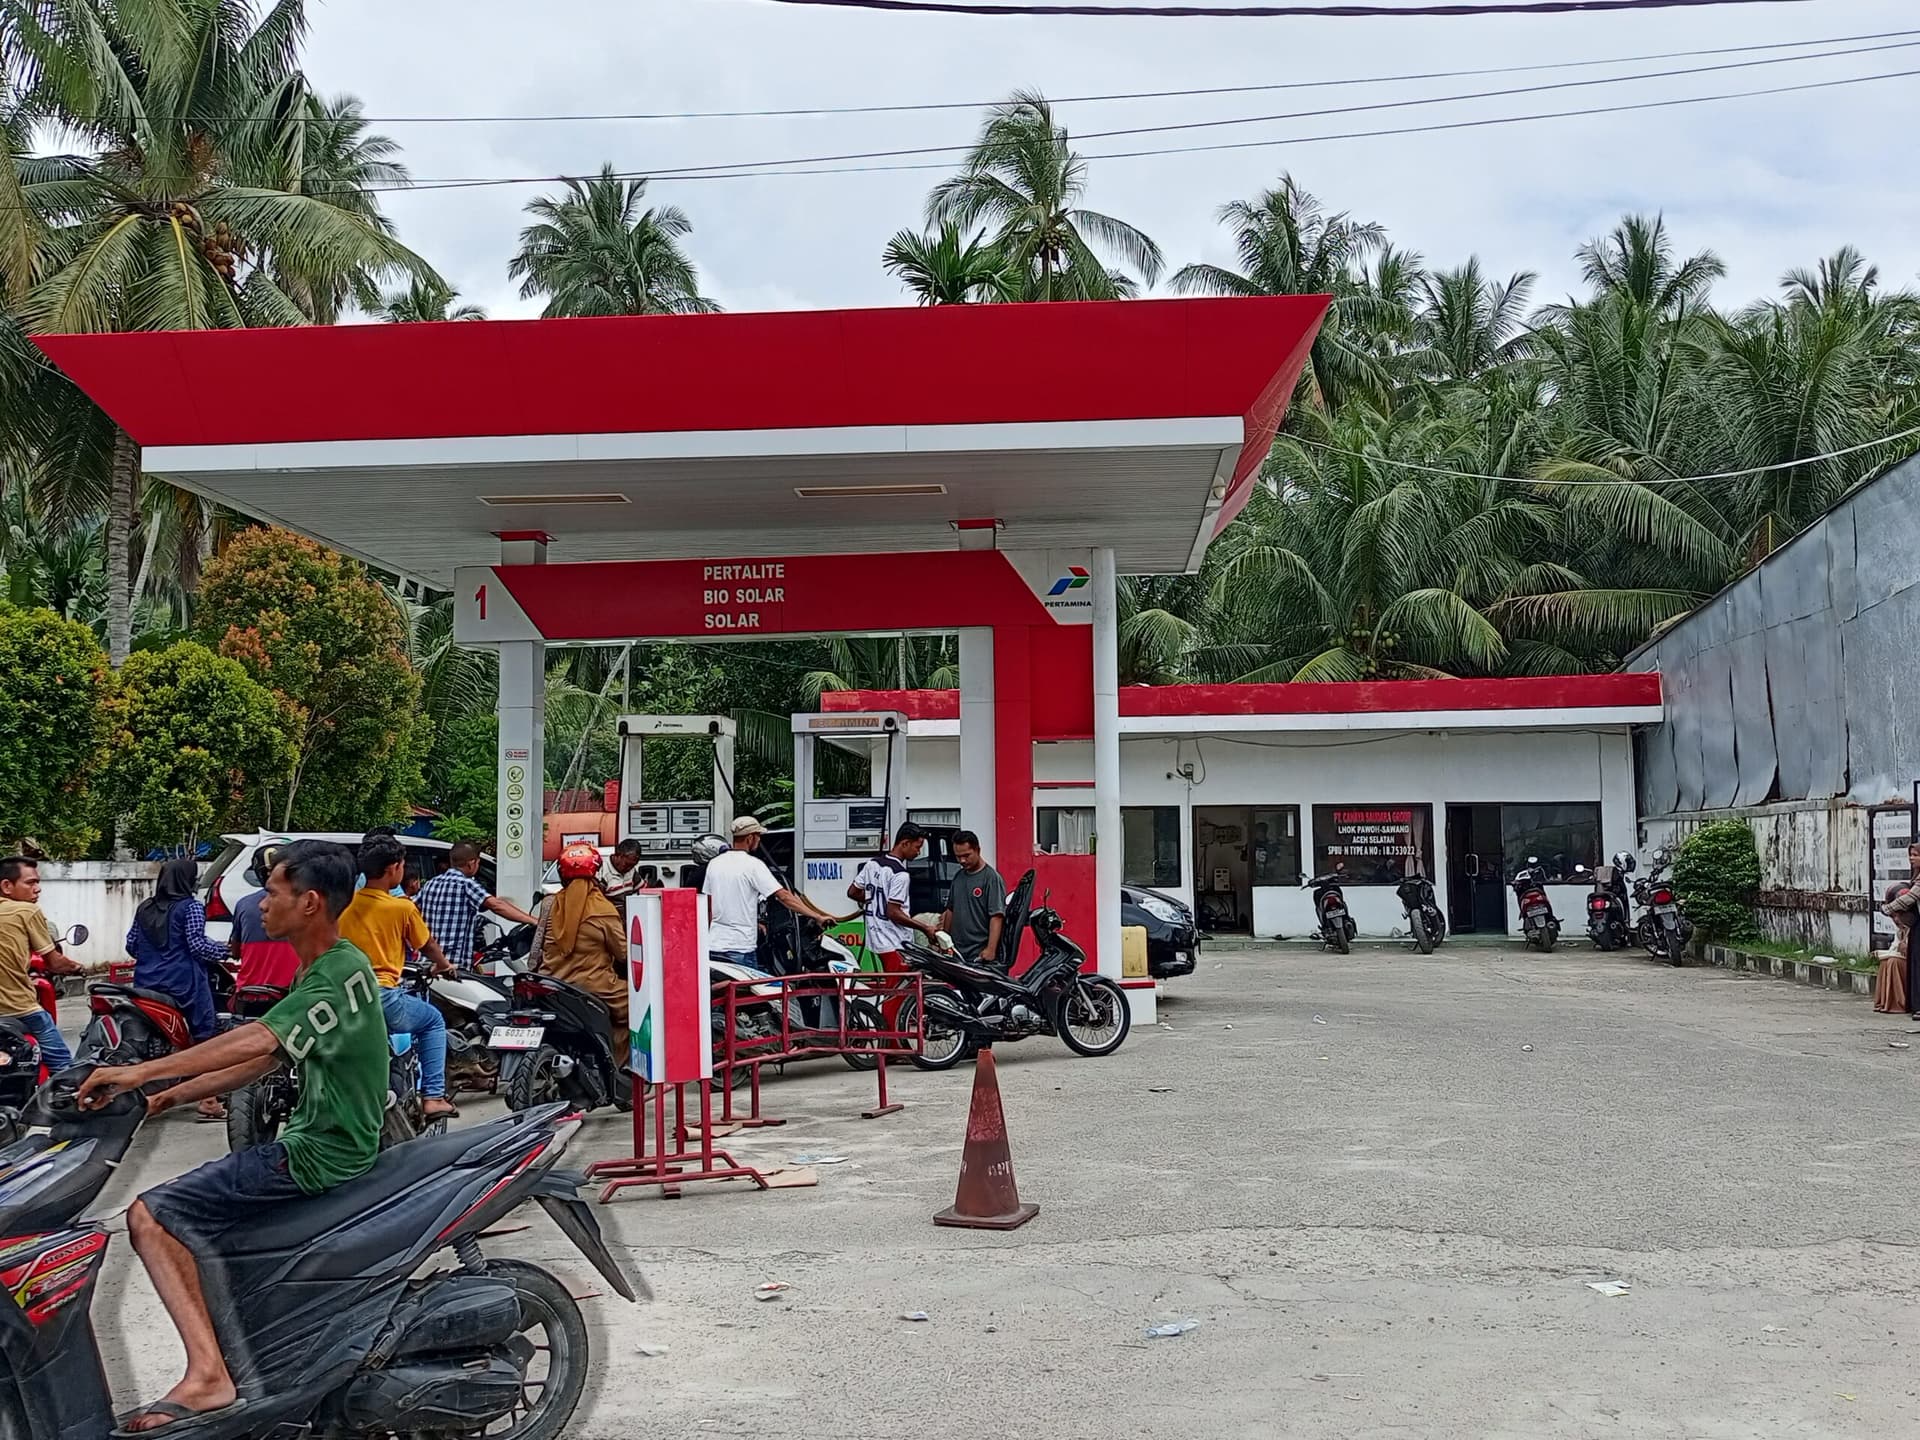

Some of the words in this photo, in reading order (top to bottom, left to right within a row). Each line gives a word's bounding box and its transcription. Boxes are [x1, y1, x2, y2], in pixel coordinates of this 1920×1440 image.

[704, 564, 785, 580] PERTALITE
[475, 584, 487, 620] 1
[704, 589, 729, 605] BIO
[736, 587, 785, 604] SOLAR
[704, 613, 760, 629] SOLAR
[1352, 835, 1368, 844] ACEH
[1369, 835, 1395, 844] SELATAN
[808, 862, 818, 880] BIO
[819, 862, 838, 880] SOLAR
[865, 884, 889, 920] 20
[44, 1240, 94, 1264] HONDA
